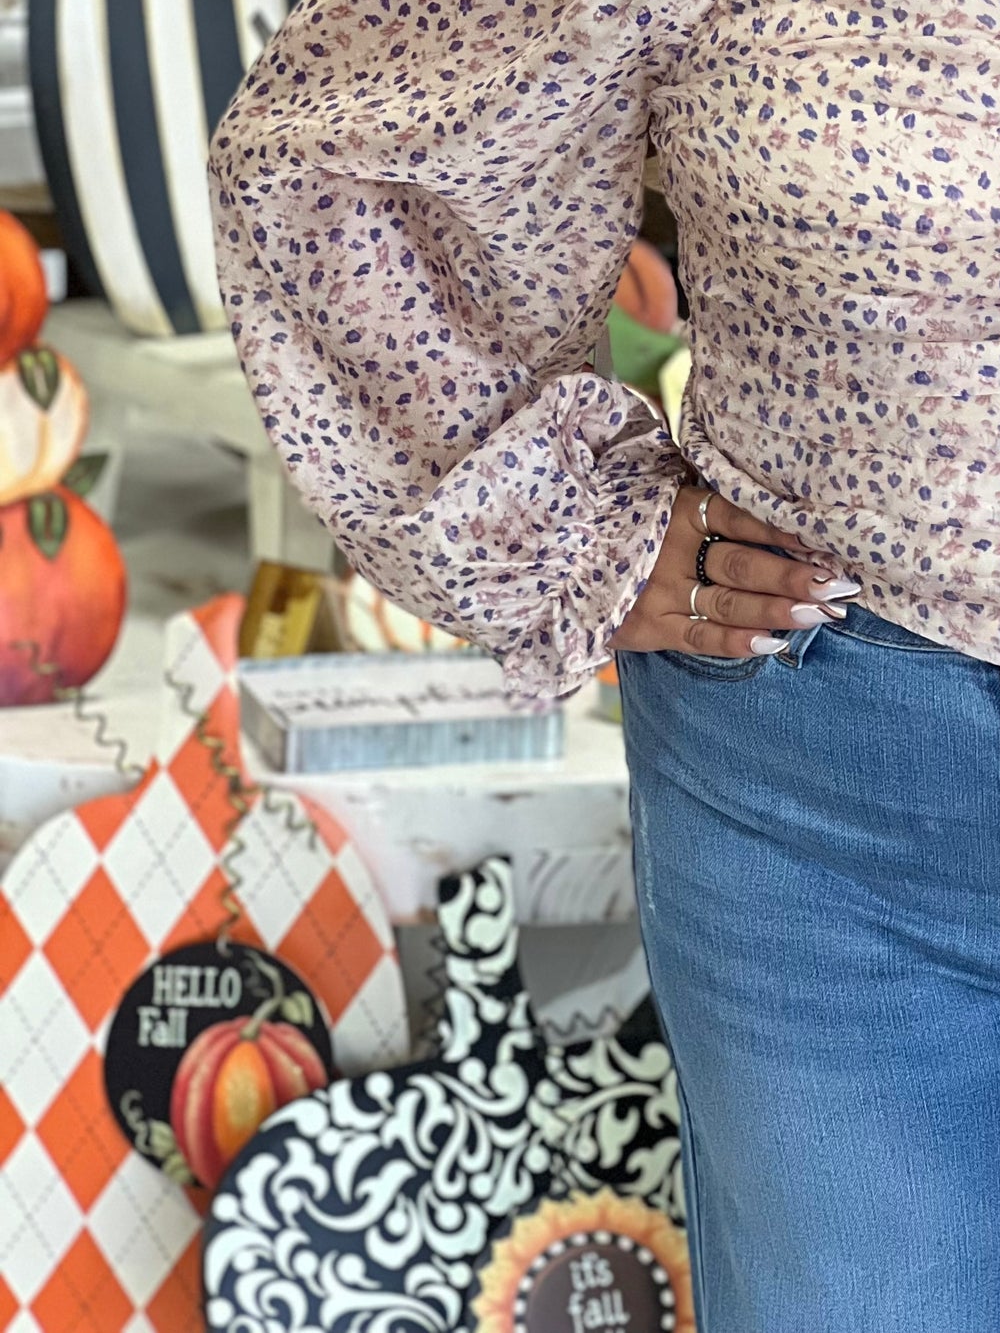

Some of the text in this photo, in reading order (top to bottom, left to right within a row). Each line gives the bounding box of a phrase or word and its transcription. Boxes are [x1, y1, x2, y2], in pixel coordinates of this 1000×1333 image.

[153, 965, 242, 1008] HELLO
[137, 1006, 188, 1047] Fall
[567, 1288, 630, 1333] fall
